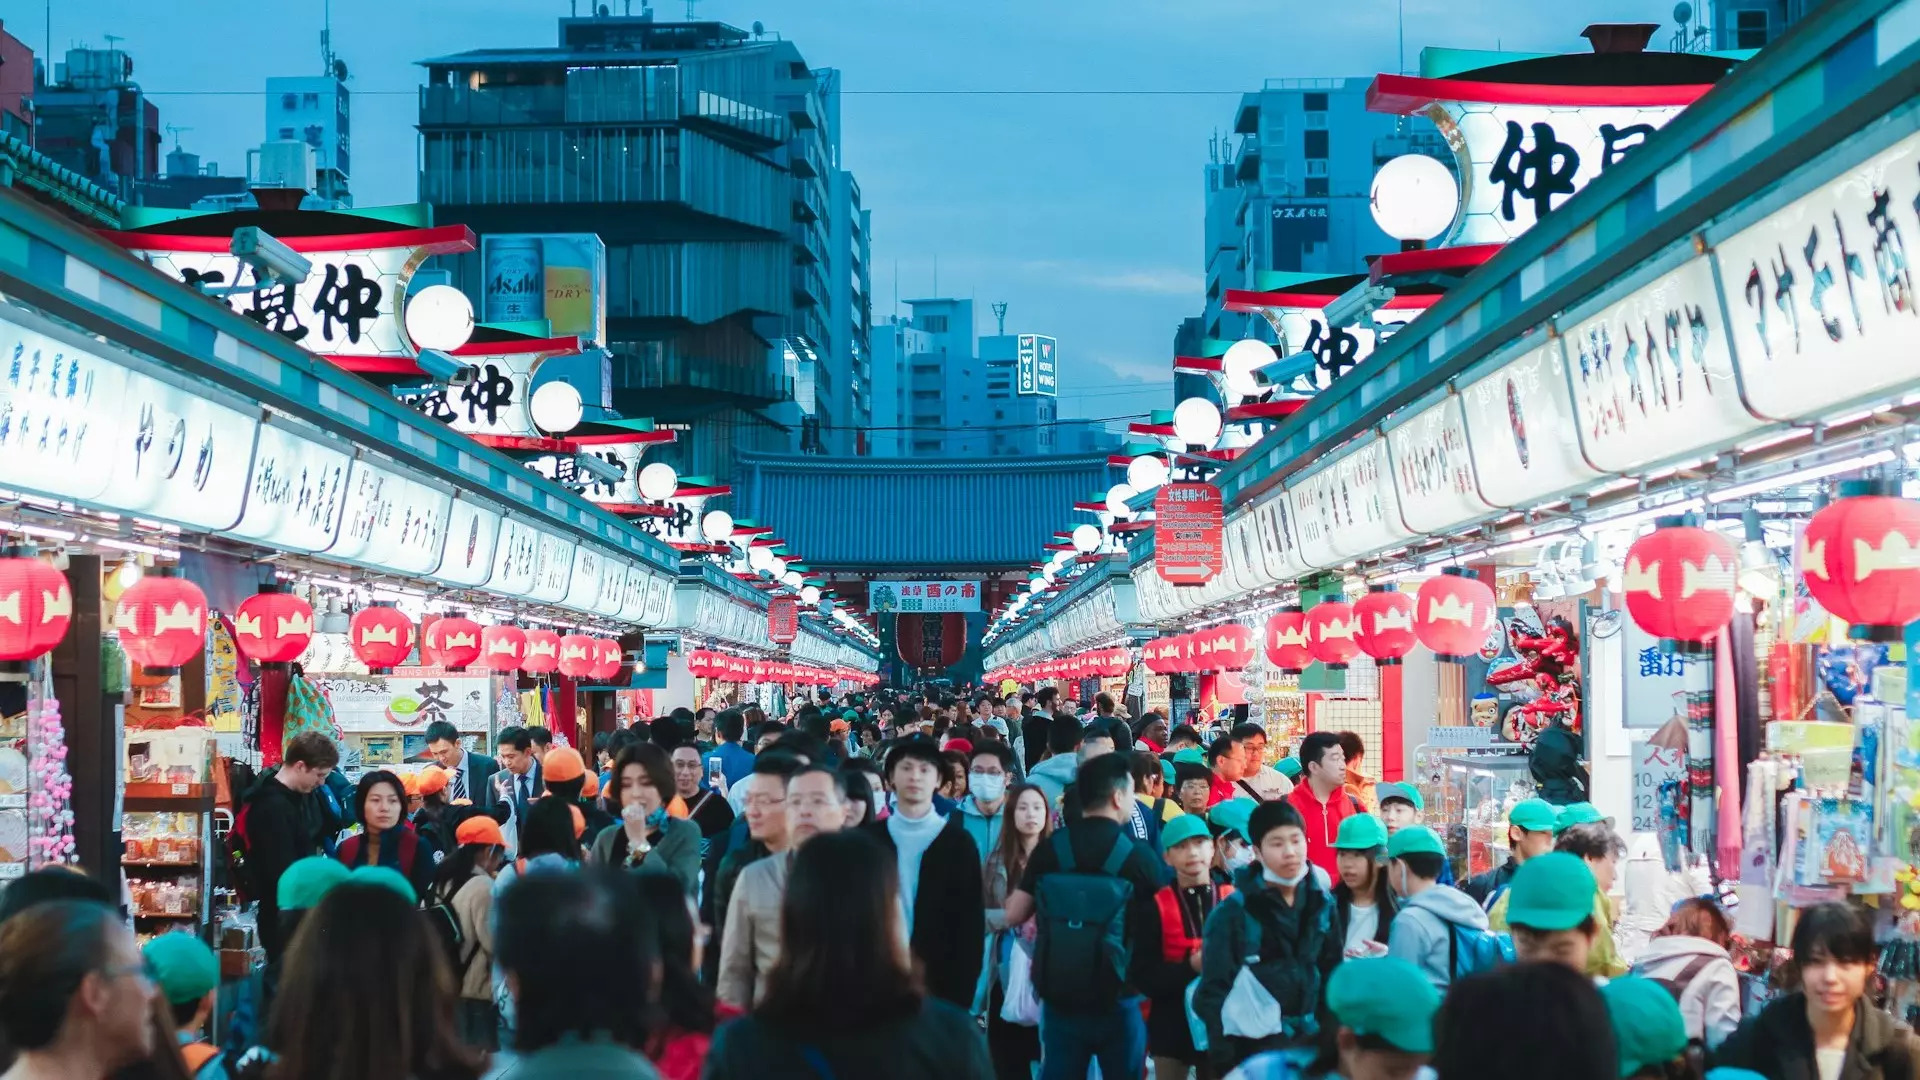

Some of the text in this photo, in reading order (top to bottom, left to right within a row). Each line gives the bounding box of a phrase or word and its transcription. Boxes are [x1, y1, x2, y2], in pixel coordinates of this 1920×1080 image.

[489, 272, 540, 295] Asahi
[506, 303, 521, 315] 生
[1021, 355, 1033, 389] WING
[1039, 361, 1054, 373] HOTEL
[1038, 373, 1055, 387] WING
[1168, 489, 1211, 502] 女性専用トイレ
[901, 583, 976, 598] 浅草 酉の市
[414, 679, 455, 722] 茶
